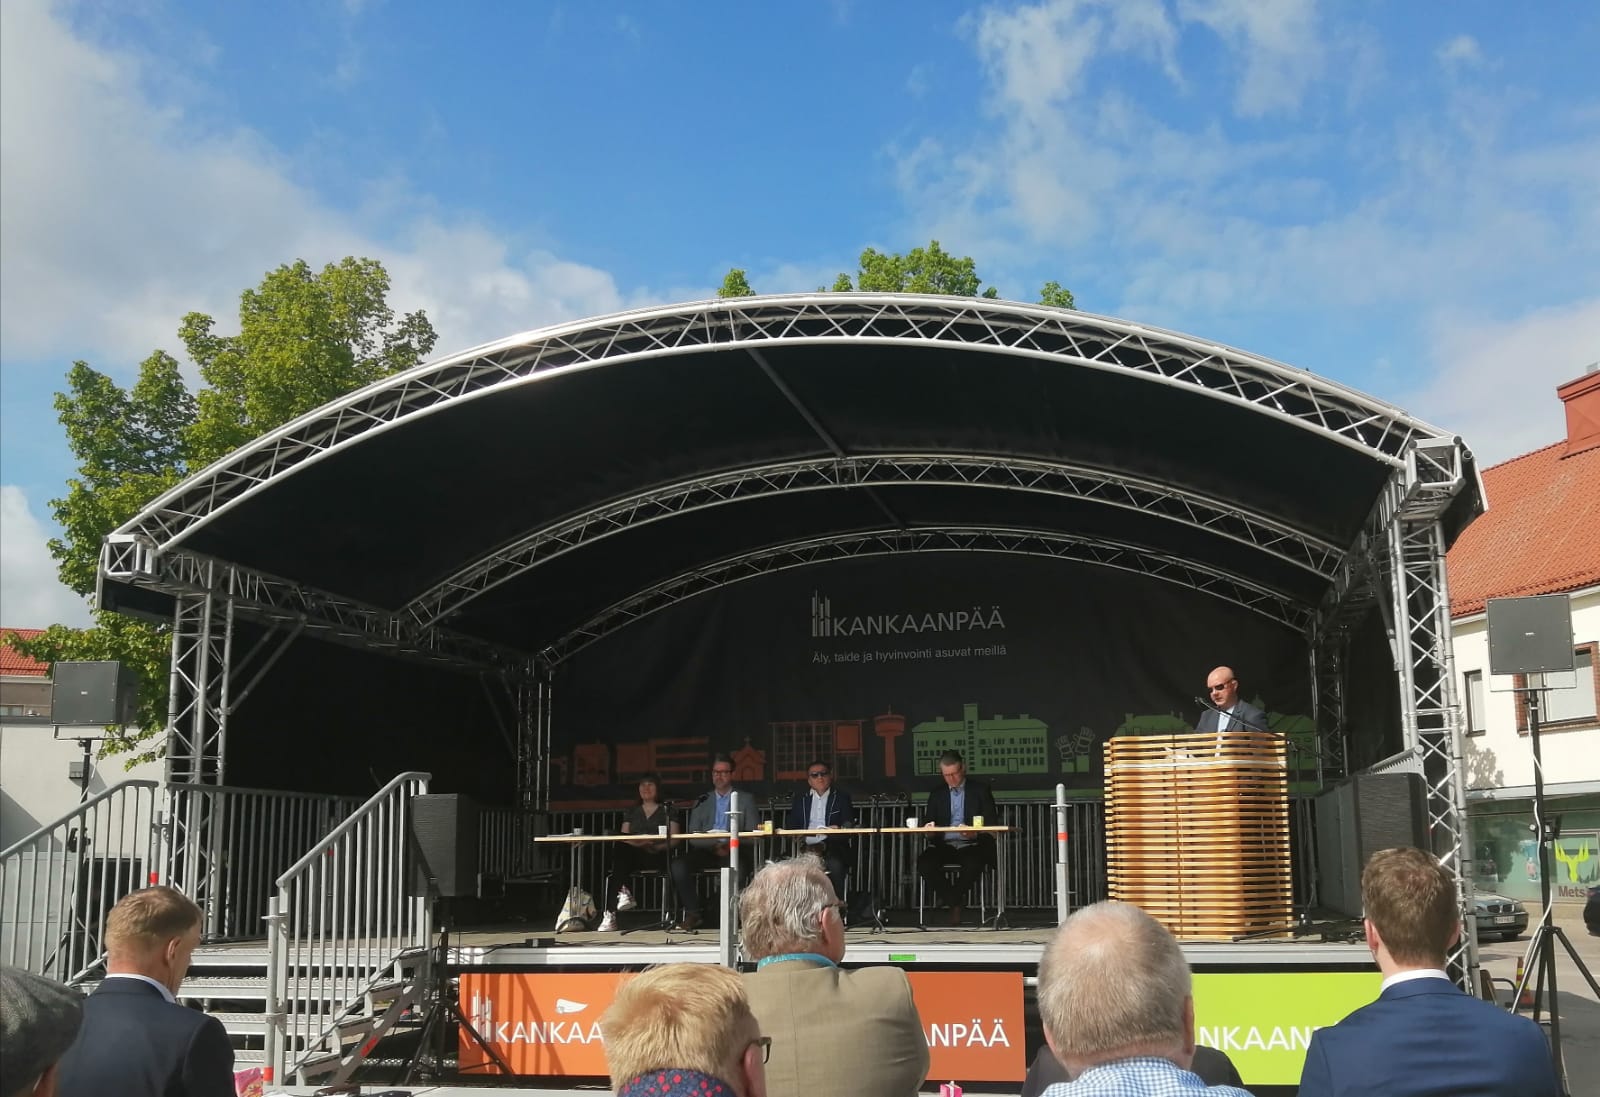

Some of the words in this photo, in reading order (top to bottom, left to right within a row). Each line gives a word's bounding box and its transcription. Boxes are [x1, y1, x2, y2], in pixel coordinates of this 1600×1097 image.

[833, 606, 1006, 637] KANKAANPÄÄ
[834, 650, 860, 663] taide
[862, 649, 873, 664] ja
[875, 648, 932, 663] hyvinvointi
[934, 646, 971, 658] asuvat
[974, 644, 1007, 657] meillä
[1558, 885, 1587, 898] Mets
[1199, 1026, 1323, 1051] NKAAN
